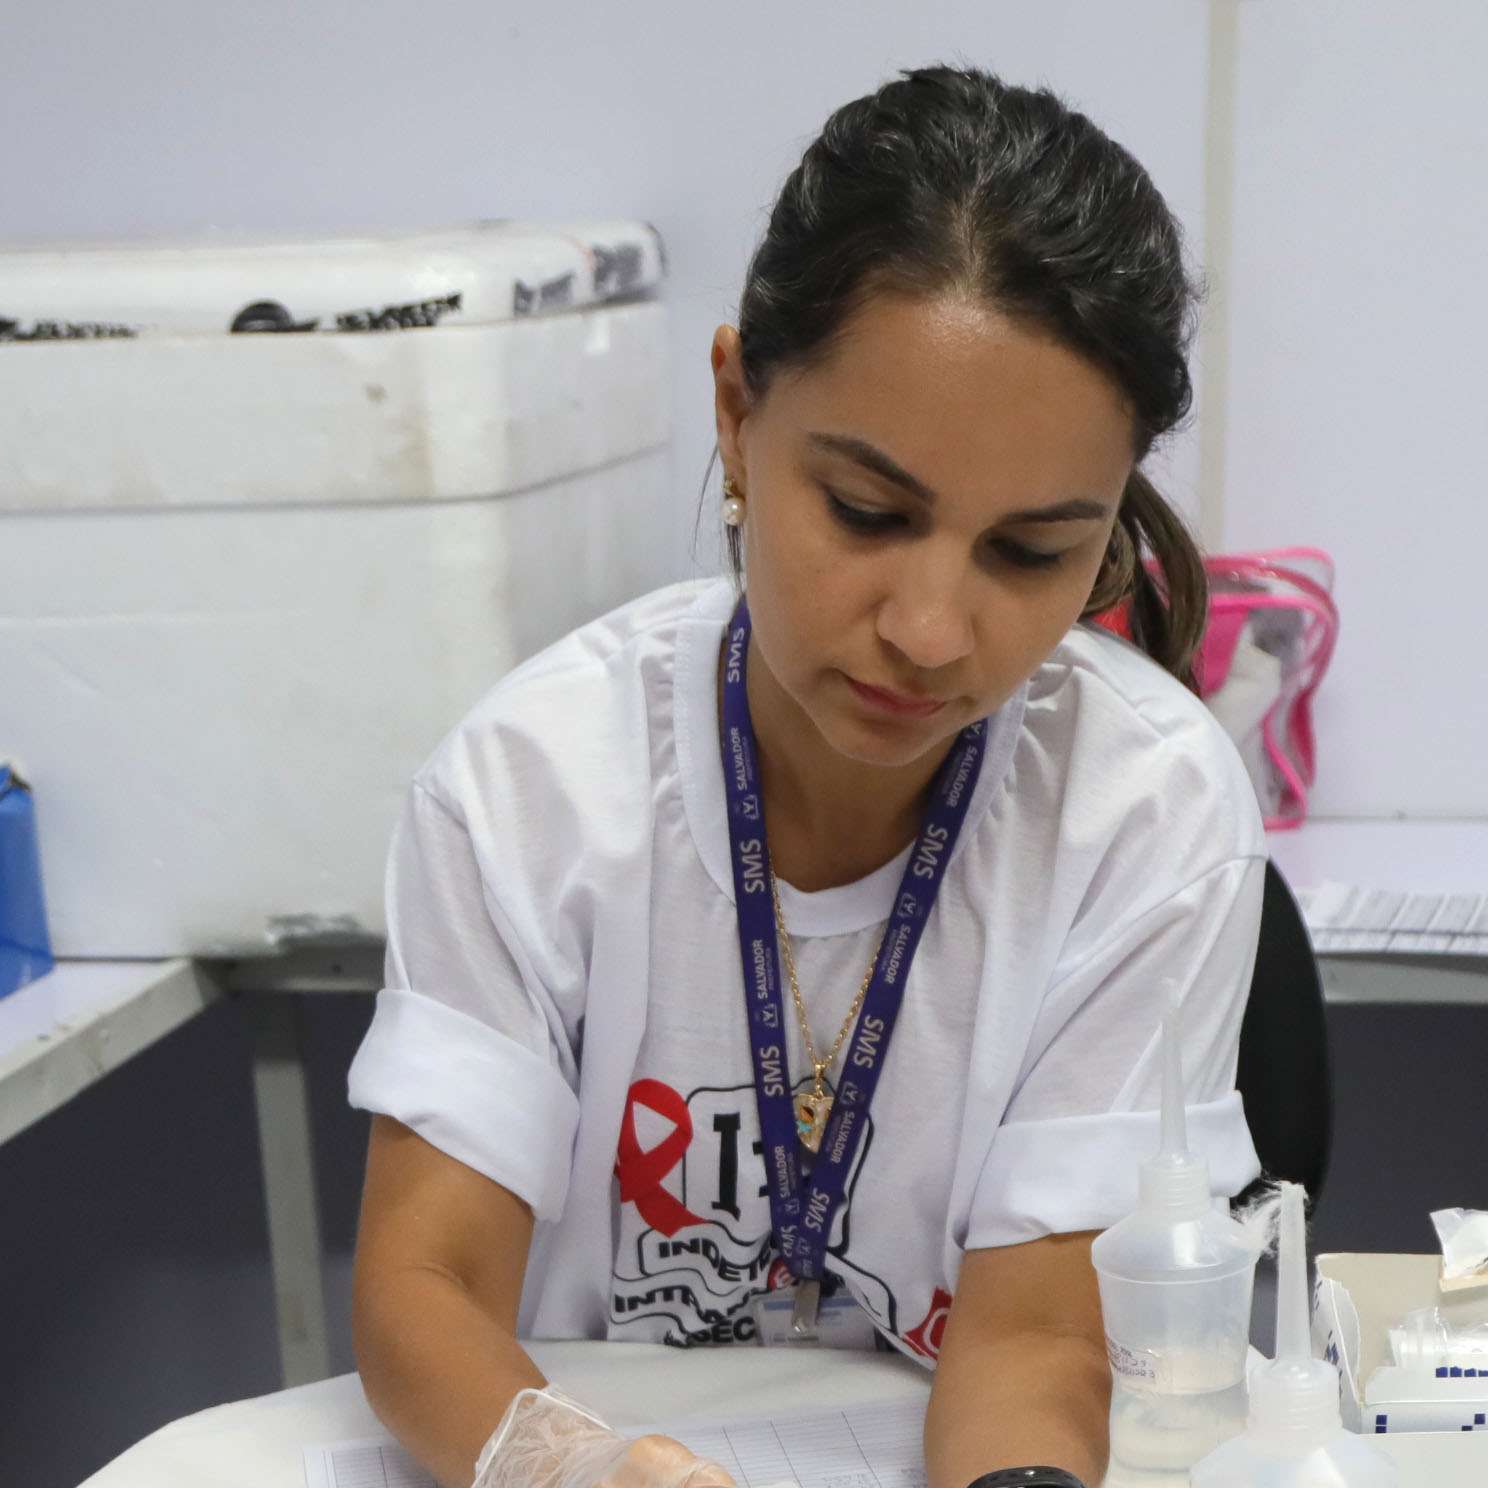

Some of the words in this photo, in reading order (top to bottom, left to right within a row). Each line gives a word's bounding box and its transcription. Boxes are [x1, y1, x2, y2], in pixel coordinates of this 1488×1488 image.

[728, 626, 745, 683] SMS
[730, 727, 748, 790] SALVADOR
[946, 745, 977, 808] SALVADOR
[740, 838, 764, 894] SMS
[913, 823, 949, 880] SMS
[753, 939, 769, 999] SALVADOR
[884, 923, 911, 985] SALVADOR
[854, 1014, 884, 1069] SMS
[760, 1045, 784, 1097] SMS
[830, 1111, 855, 1164] SALVADOR
[805, 1188, 830, 1233] SMS
